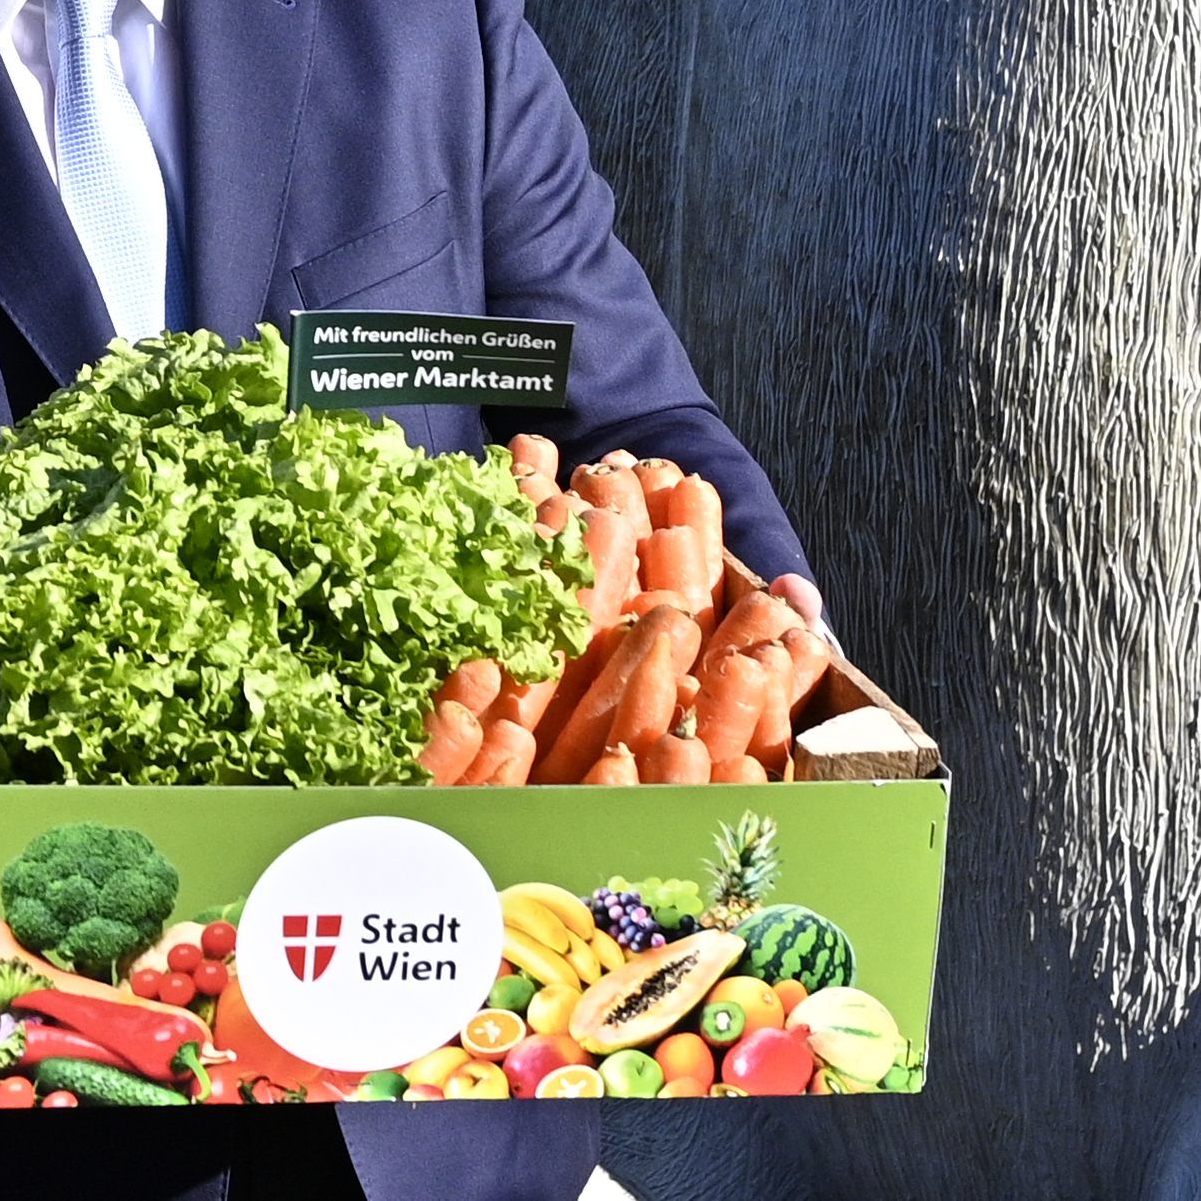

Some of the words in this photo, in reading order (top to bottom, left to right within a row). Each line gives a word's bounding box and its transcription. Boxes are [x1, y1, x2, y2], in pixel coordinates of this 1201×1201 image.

[313, 326, 348, 345] Mit
[351, 325, 477, 346] freundlichen
[481, 331, 557, 351] Grüßen
[410, 349, 455, 362] vom
[310, 368, 409, 392] Wiener
[413, 366, 554, 392] Marktamt
[361, 913, 461, 945] Stadt
[359, 951, 457, 981] Wien
